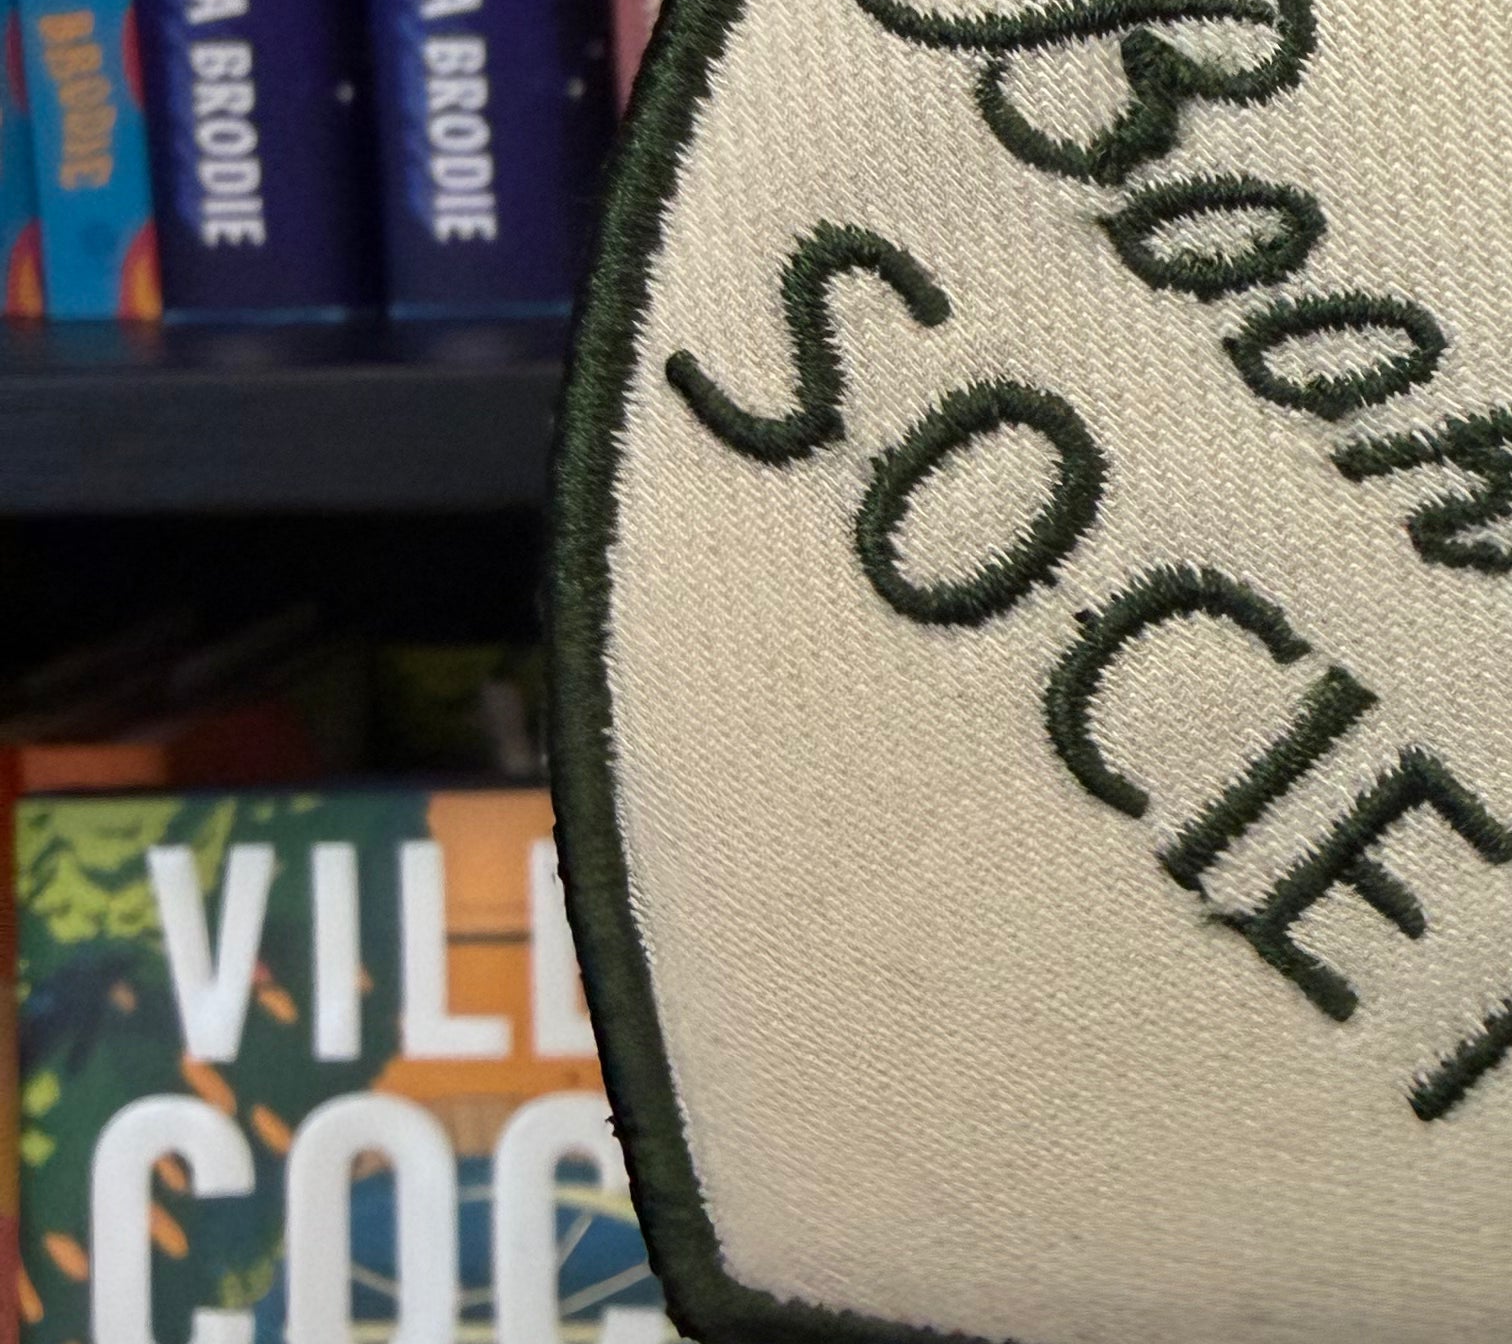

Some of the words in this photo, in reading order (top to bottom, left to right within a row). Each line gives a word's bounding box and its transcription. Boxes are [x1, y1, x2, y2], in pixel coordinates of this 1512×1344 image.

[190, 39, 266, 248] BRODIE
[423, 35, 498, 244] BRODIE
[146, 840, 600, 1062] VILL
